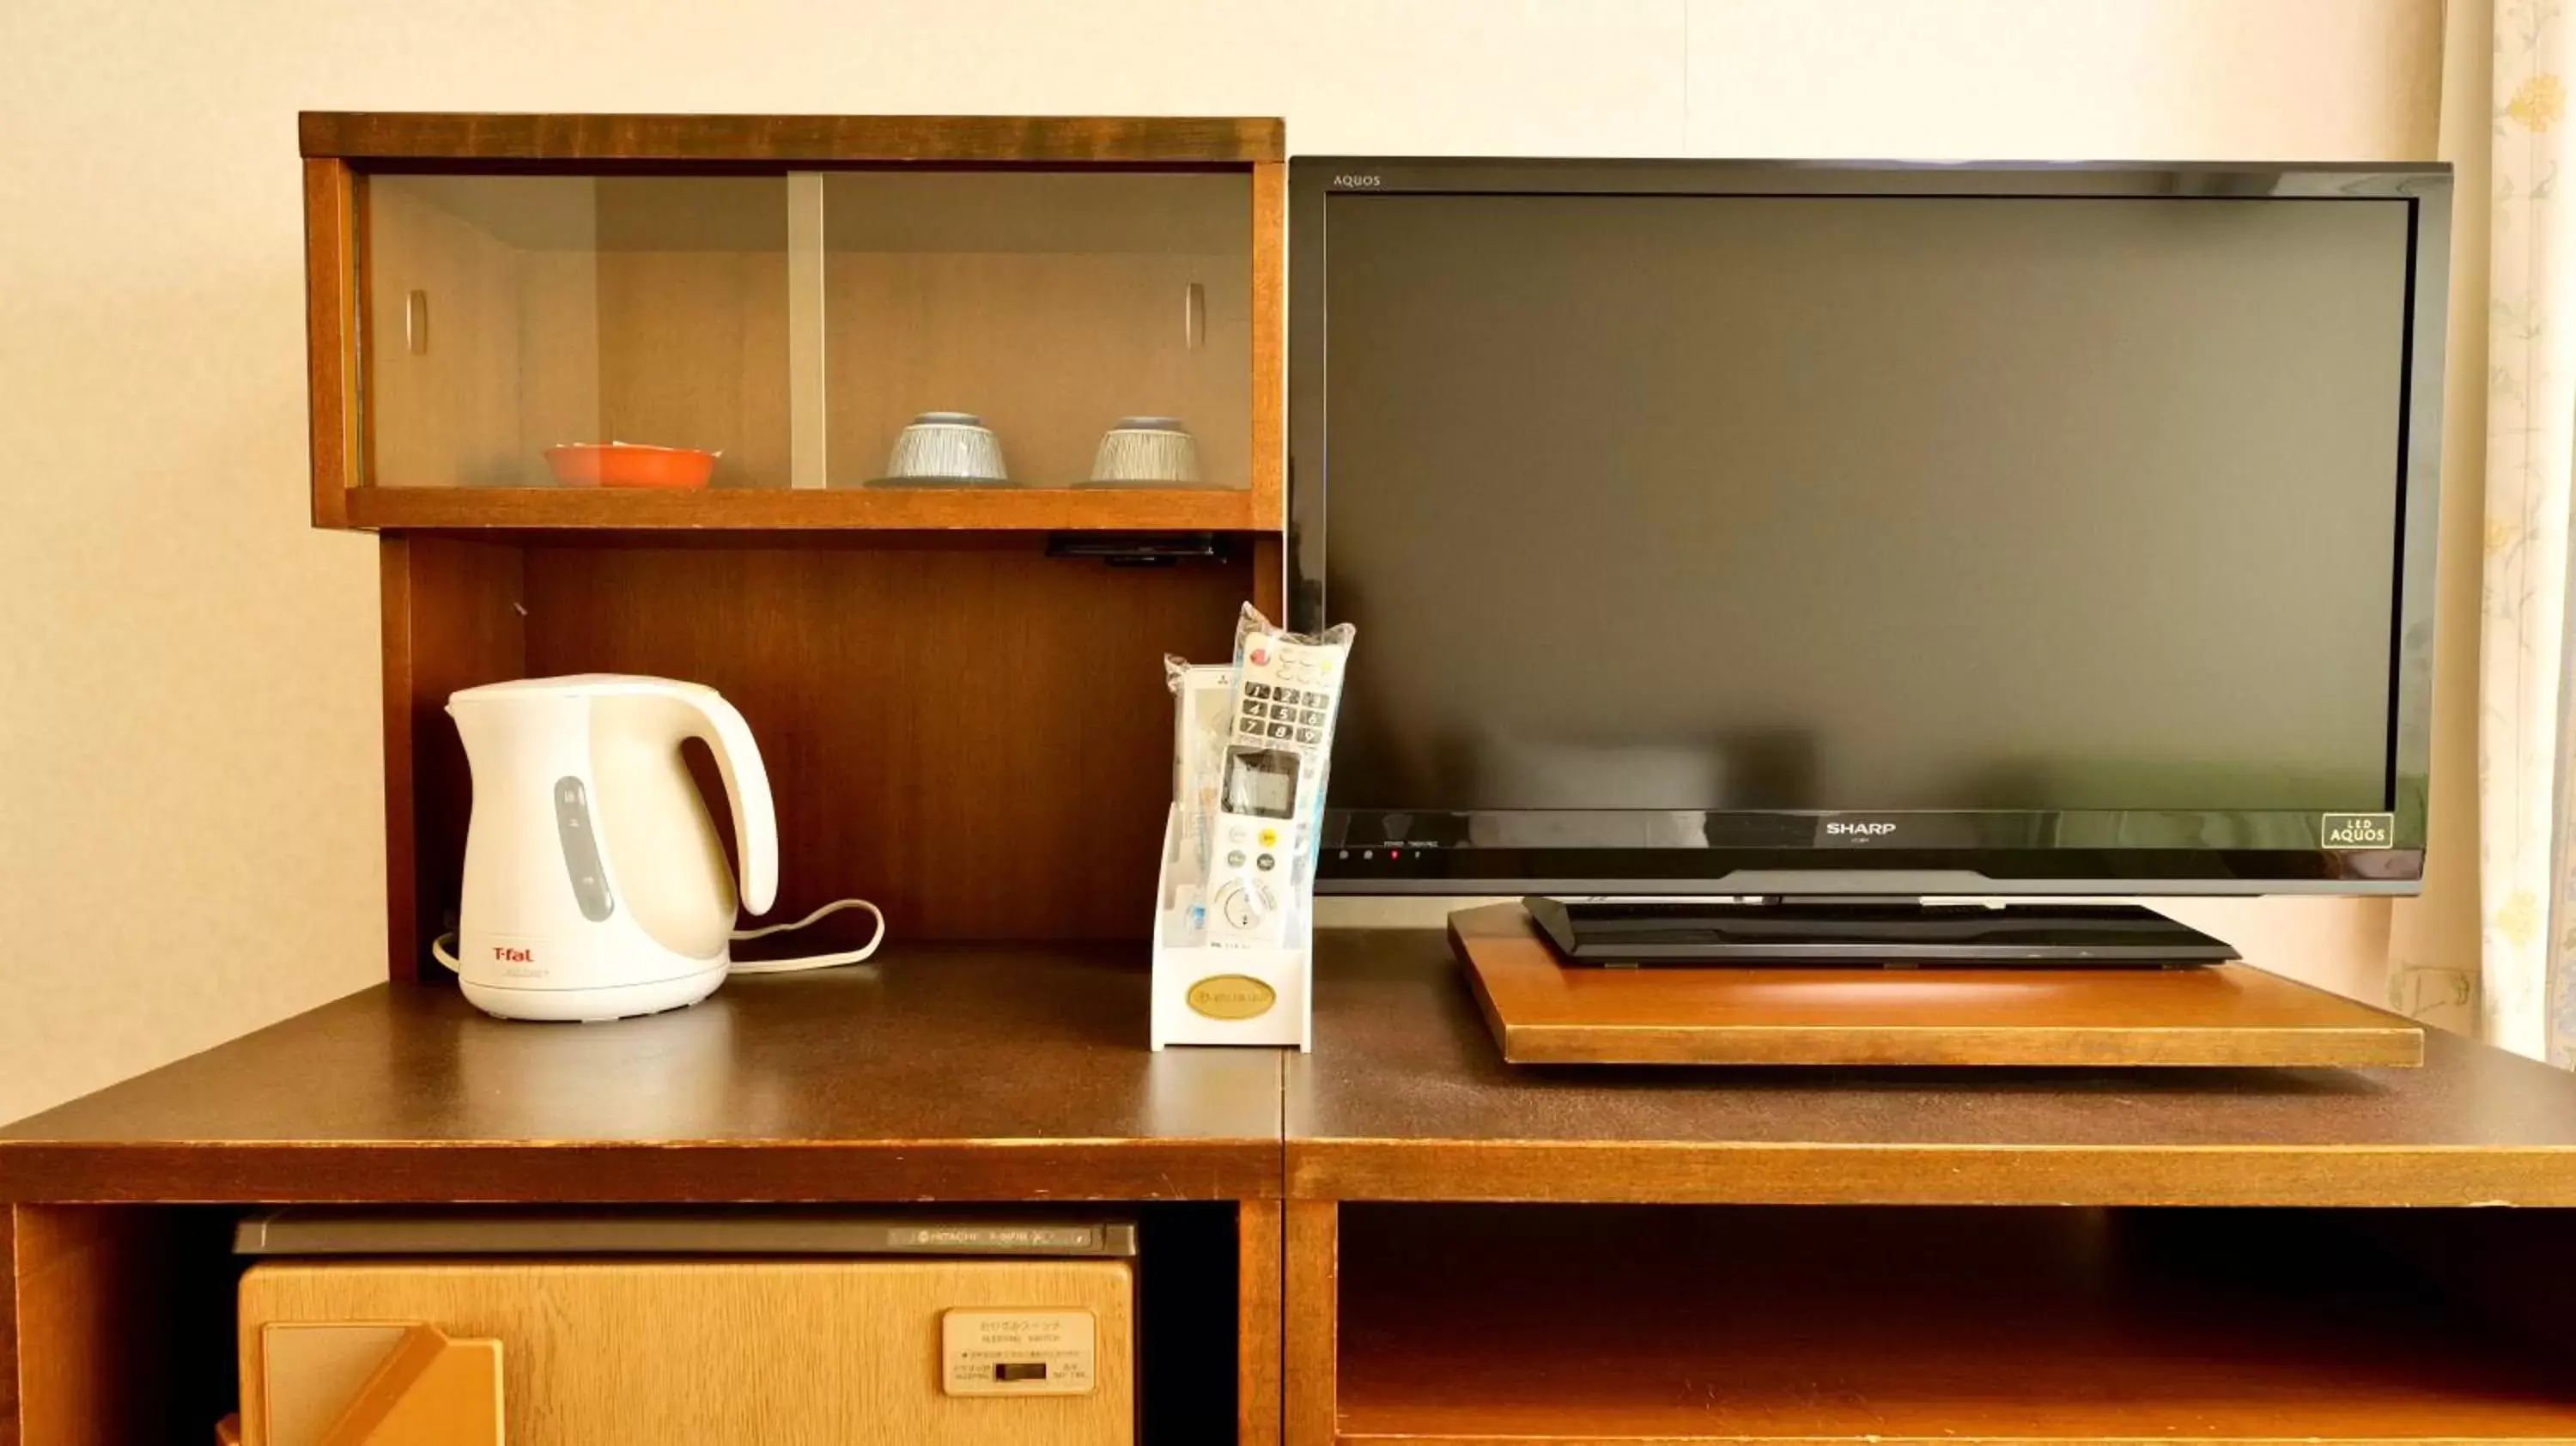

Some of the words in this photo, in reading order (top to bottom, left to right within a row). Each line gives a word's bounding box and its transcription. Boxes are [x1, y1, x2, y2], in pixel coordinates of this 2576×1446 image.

[1334, 174, 1381, 188] AQUOS
[1826, 823, 1896, 835] SHARP
[2347, 819, 2372, 829] LED
[2330, 829, 2385, 843] AQUOS
